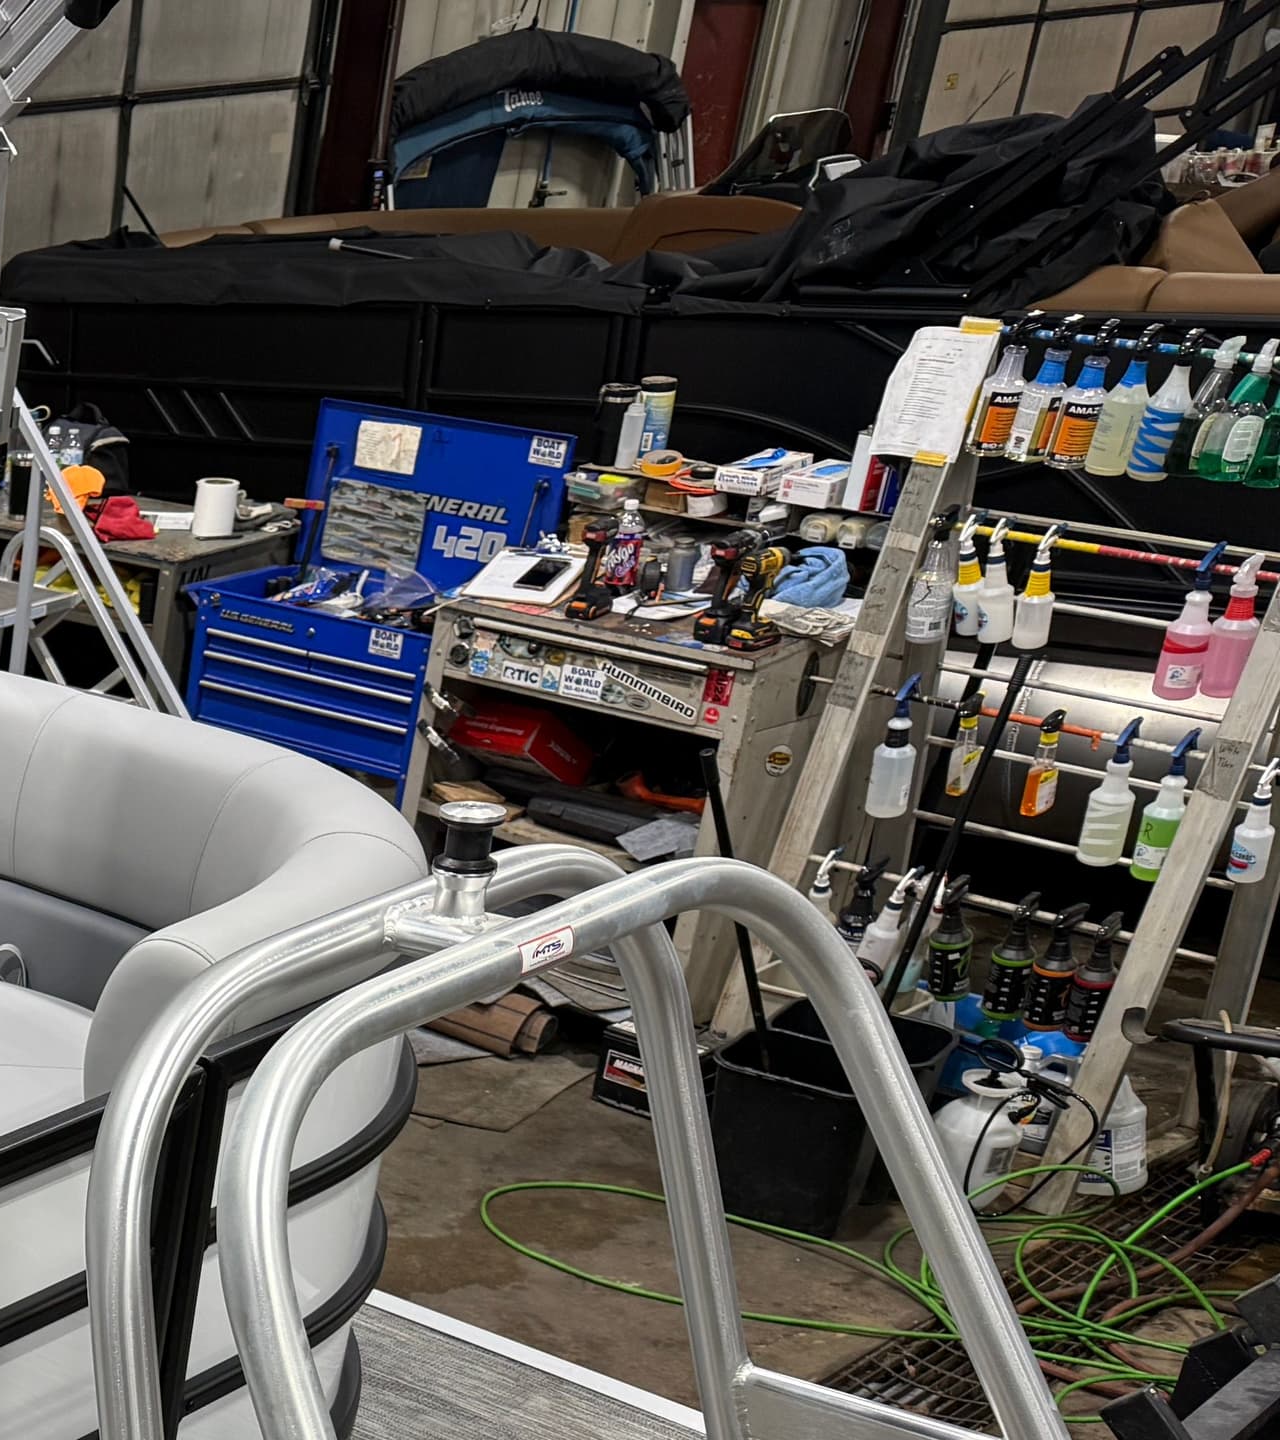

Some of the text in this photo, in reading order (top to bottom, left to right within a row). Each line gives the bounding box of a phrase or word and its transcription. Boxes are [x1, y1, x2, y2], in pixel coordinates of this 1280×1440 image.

[496, 88, 544, 112] Tahoe
[536, 437, 562, 450] BOAT
[432, 525, 507, 564] 420
[374, 630, 398, 643] BOAT
[503, 666, 539, 685] RTIC
[571, 667, 597, 678] BOAT
[564, 675, 602, 689] WORLD
[601, 662, 695, 719] HUMMINBIRD
